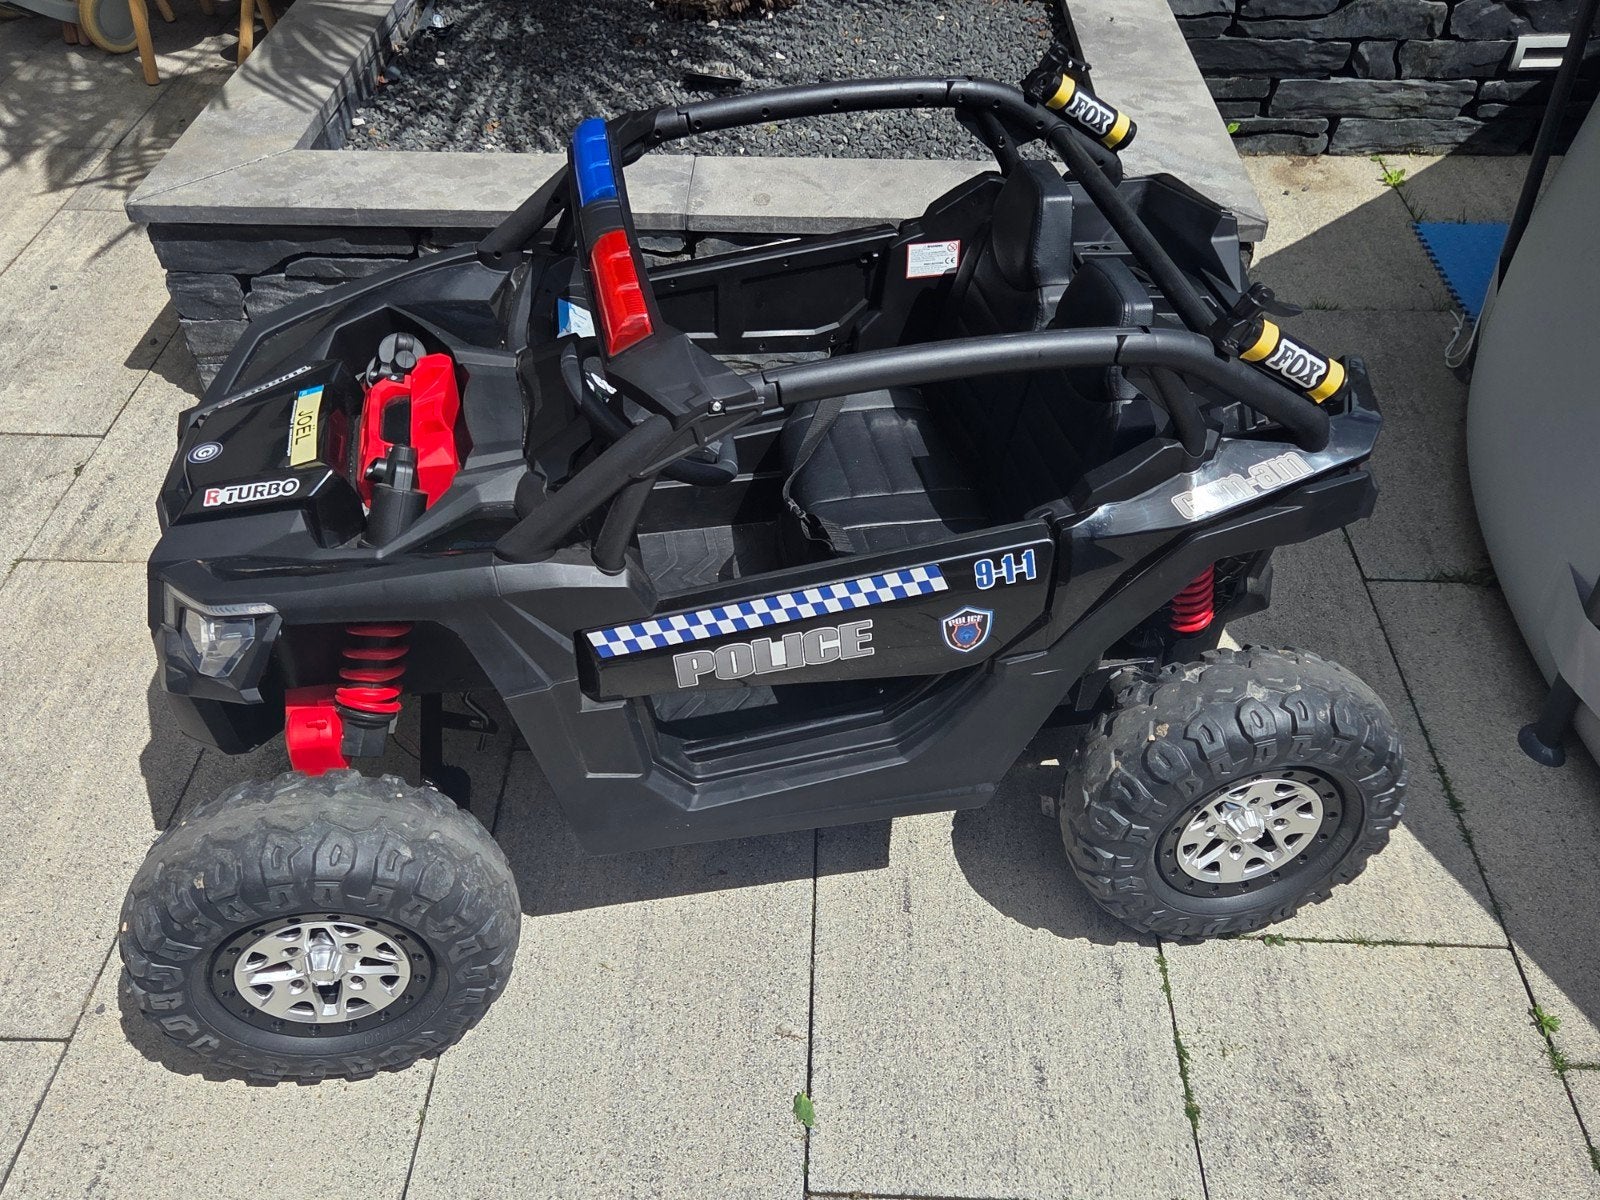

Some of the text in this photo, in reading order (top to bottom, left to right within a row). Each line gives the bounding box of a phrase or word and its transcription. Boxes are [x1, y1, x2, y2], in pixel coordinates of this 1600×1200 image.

[1067, 93, 1113, 134] FOX
[1267, 341, 1325, 387] FOX
[295, 410, 316, 446] JOËL
[205, 479, 298, 505] R TURBO
[1172, 452, 1313, 518] cn-am
[974, 549, 1036, 590] 9-1-1
[948, 615, 983, 627] POLICE
[673, 619, 875, 688] POLICE
